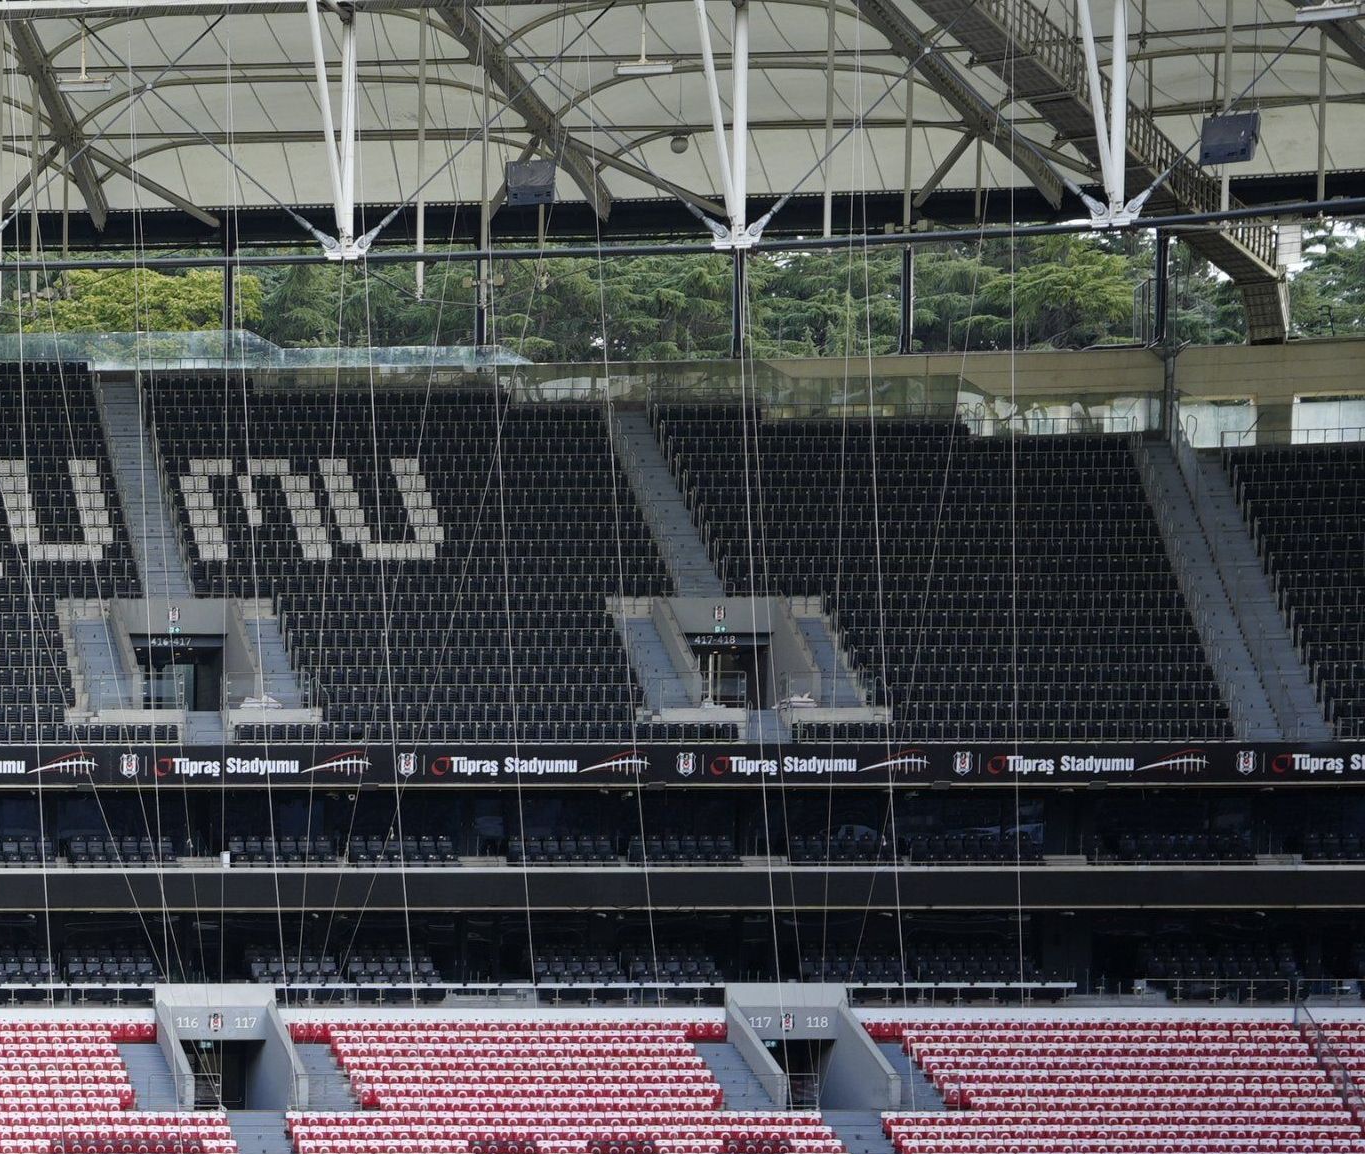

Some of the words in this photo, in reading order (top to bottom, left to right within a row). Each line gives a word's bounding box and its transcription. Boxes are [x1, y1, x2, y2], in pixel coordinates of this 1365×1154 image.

[172, 757, 221, 776] Tüpraş
[225, 757, 300, 775] Stadyumu
[450, 757, 499, 776] Tüpraş
[503, 757, 578, 775] Stadyumu
[729, 756, 778, 775] Tüpraş
[783, 756, 858, 774] Stadyumu
[1006, 755, 1055, 774] Tüpraş
[1059, 755, 1136, 773] Stadyumu
[1291, 753, 1344, 774] Tüpraş
[175, 1016, 199, 1029] 116
[234, 1016, 257, 1029] 117
[748, 1016, 772, 1028] 117
[806, 1016, 829, 1028] 118
